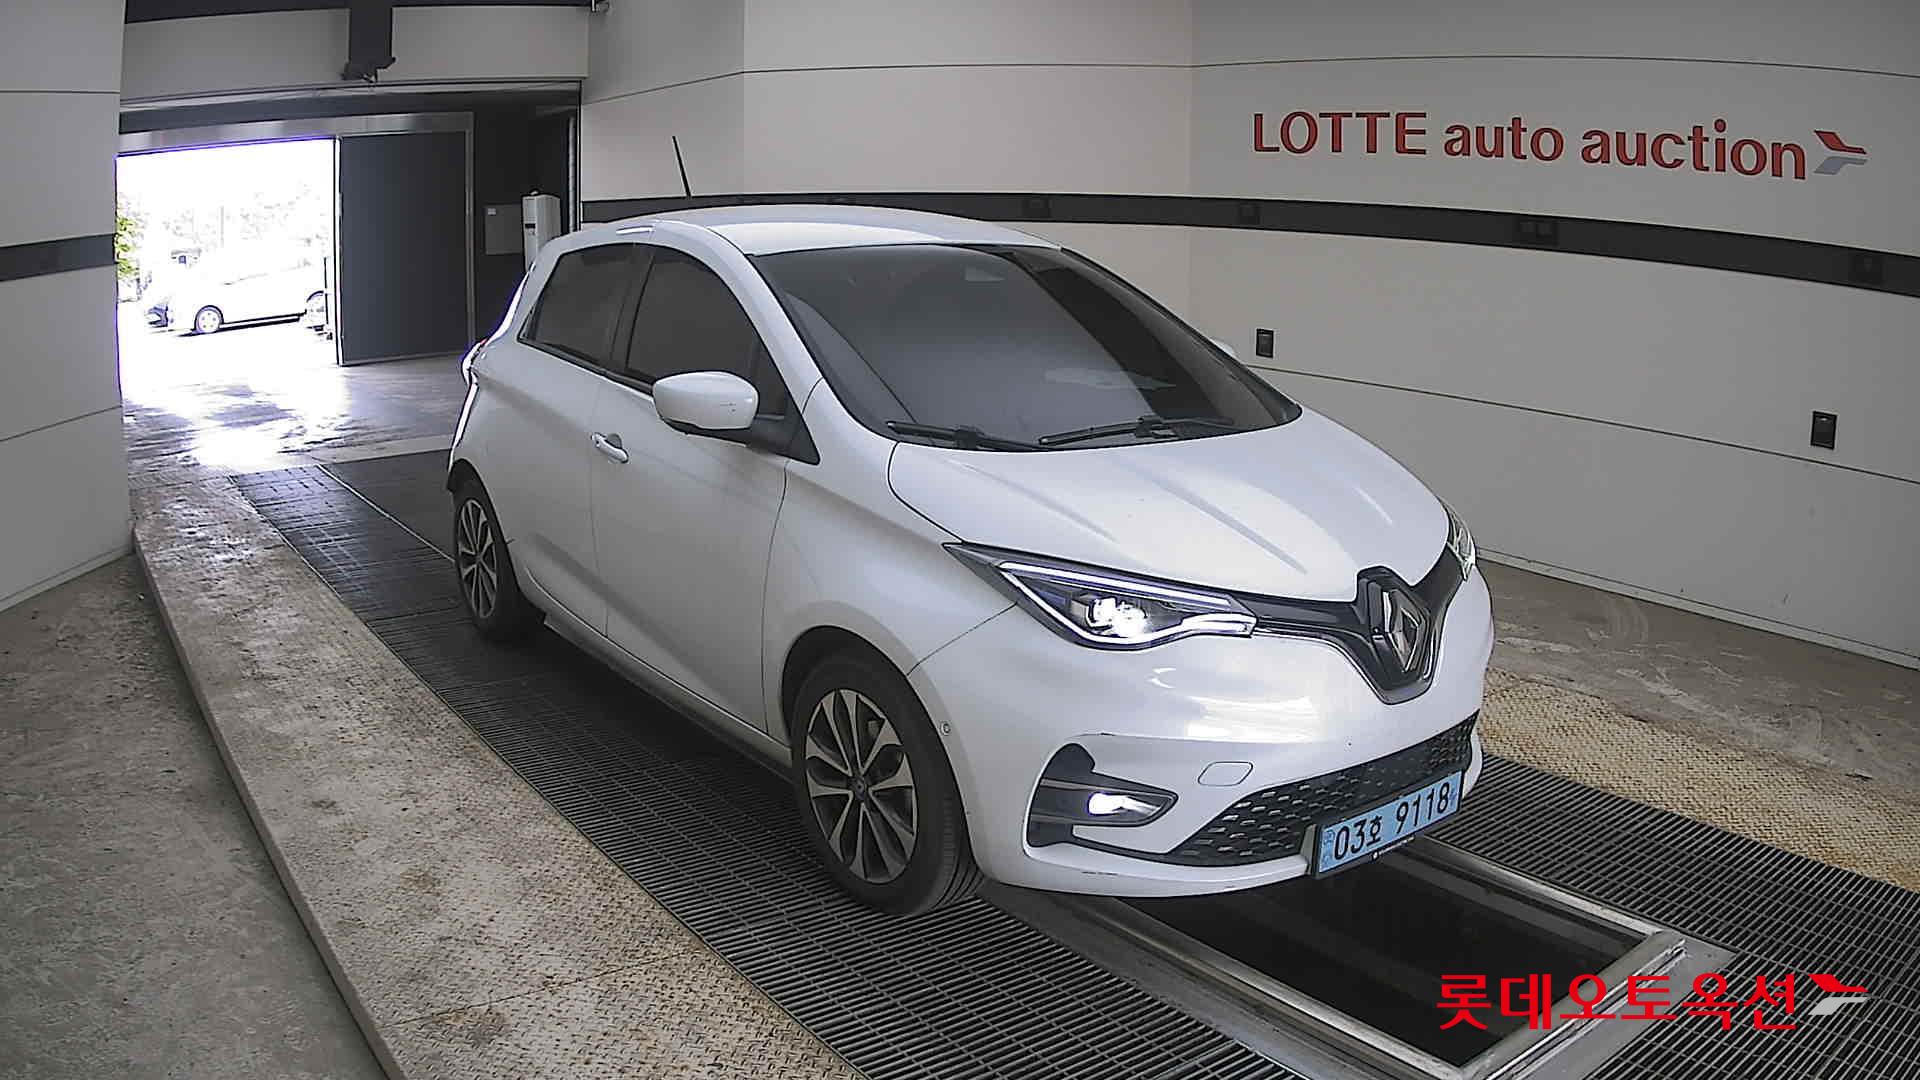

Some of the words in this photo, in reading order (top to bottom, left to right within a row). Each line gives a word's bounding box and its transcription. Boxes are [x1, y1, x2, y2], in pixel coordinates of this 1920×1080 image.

[1254, 112, 1427, 155] LOTTE
[1443, 117, 1564, 161] auto
[1581, 118, 1806, 180] auction
[1335, 816, 1383, 860] 03호
[1397, 782, 1450, 834] 9118
